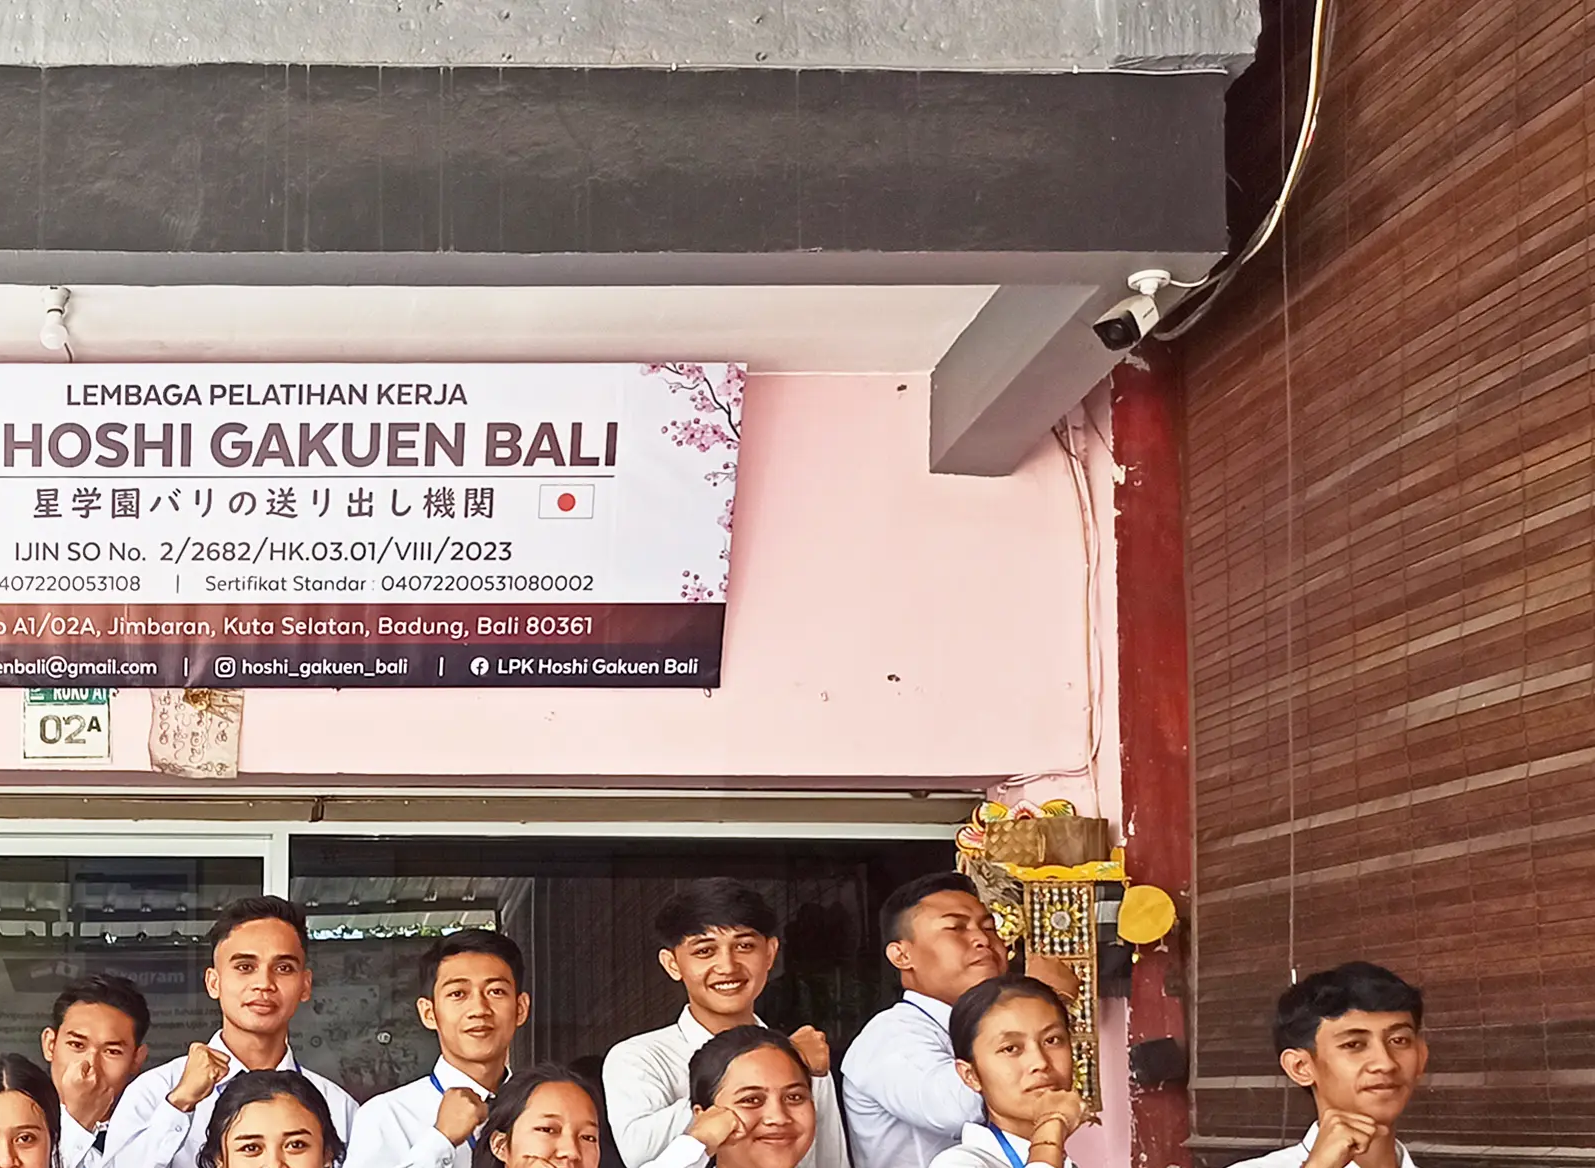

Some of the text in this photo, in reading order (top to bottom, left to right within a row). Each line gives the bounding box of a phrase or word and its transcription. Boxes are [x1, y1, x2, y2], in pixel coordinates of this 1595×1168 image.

[66, 383, 468, 406] LEMBAGA PELATIHAN KERJA
[3, 422, 192, 468] HOSHI
[209, 422, 466, 468] GAKUEN
[485, 422, 619, 467] BALI
[32, 486, 496, 520] 星学園バリの送り出し機関
[14, 536, 513, 564] IJIN SO No. 2/2682/HK.03.01/VIII/2023
[205, 574, 288, 592] Sertifikat
[293, 574, 366, 592] Standar
[380, 575, 594, 592] 04072200531080002
[12, 613, 102, 638] A1/02A,
[107, 616, 216, 638] Jimbaran,
[223, 616, 275, 636] Kuta
[281, 616, 370, 638] Selatan,
[377, 616, 470, 640] Badung,
[476, 616, 520, 636] Bali
[525, 616, 593, 636] 80361
[241, 657, 409, 678] hoshi_gakuen_bali
[497, 657, 699, 676] LPK Hoshi Gakuen Bali
